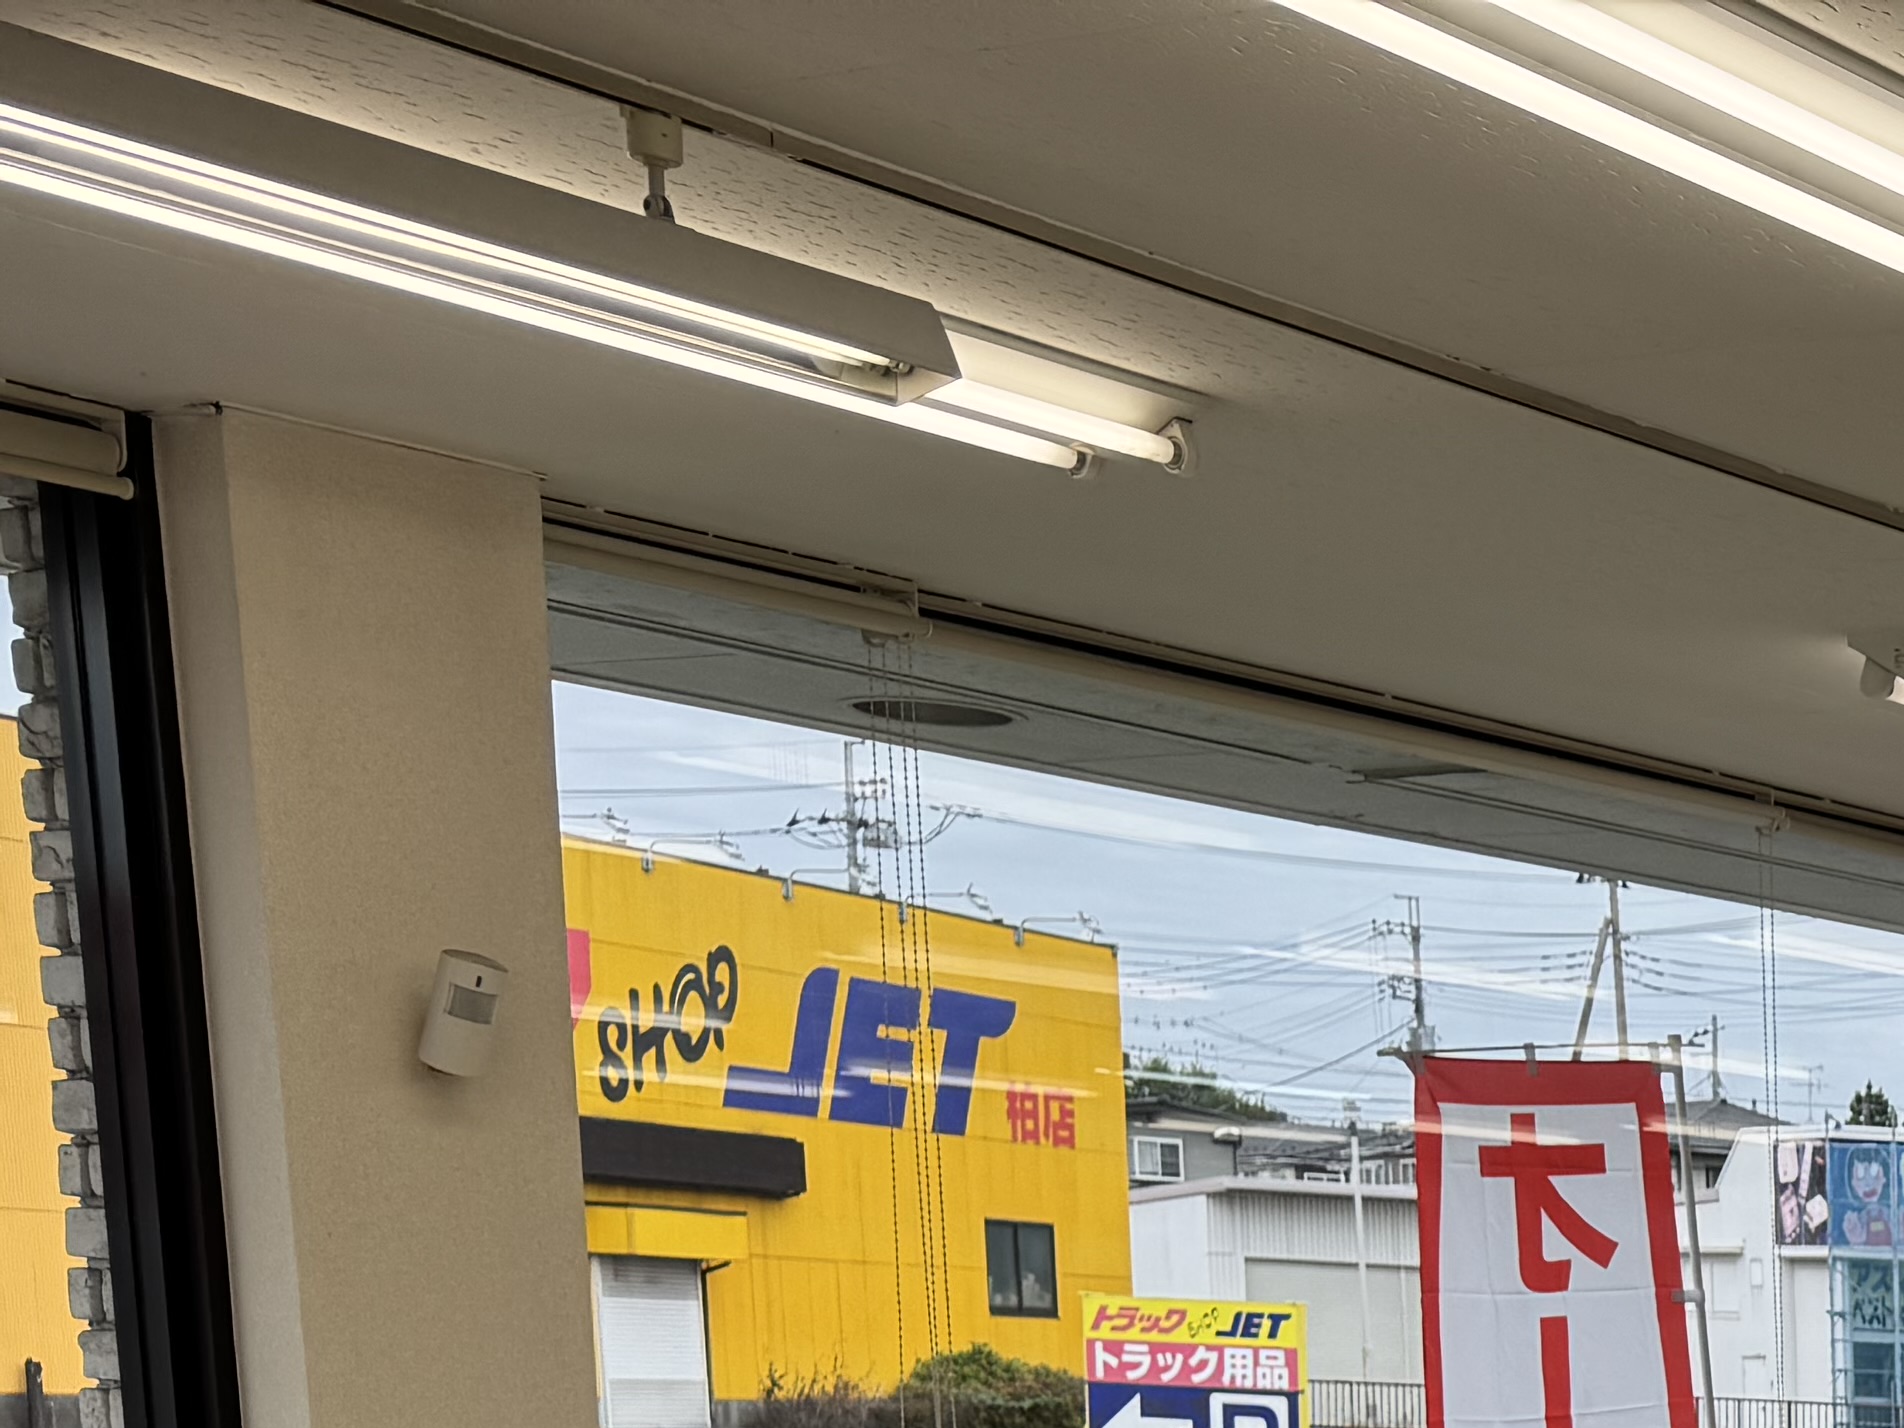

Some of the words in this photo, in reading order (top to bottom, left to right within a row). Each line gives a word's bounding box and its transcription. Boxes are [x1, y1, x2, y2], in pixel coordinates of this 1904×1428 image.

[597, 944, 739, 1103] SHOP
[722, 966, 1016, 1137] JET
[1005, 1080, 1077, 1150] 柏店
[1090, 1304, 1188, 1335] トラック
[1215, 1311, 1292, 1340] JET
[1093, 1340, 1290, 1391] トラック用品
